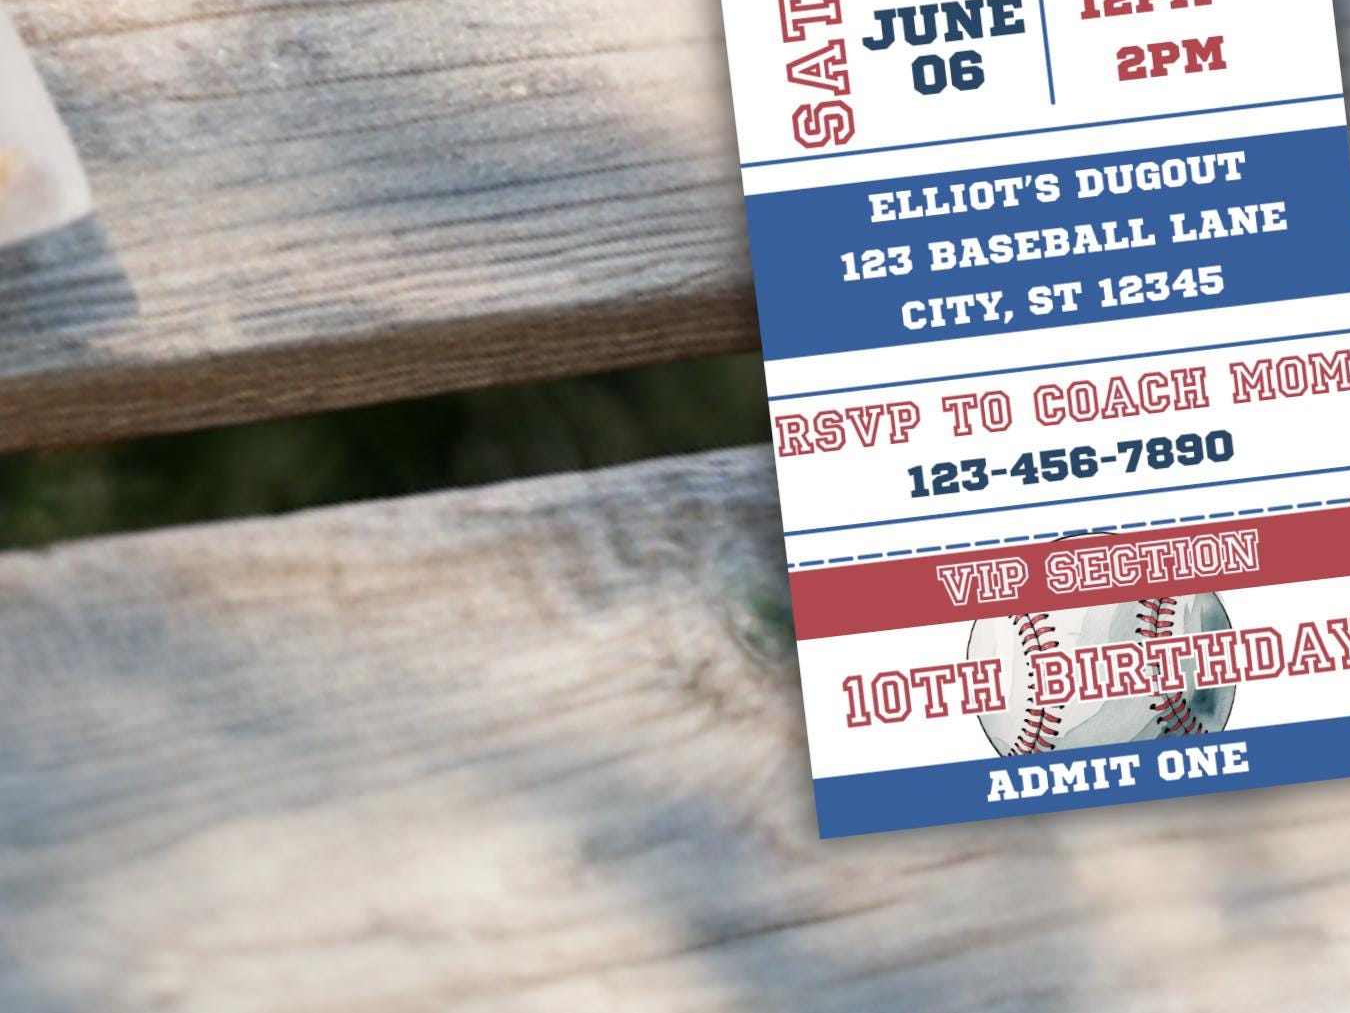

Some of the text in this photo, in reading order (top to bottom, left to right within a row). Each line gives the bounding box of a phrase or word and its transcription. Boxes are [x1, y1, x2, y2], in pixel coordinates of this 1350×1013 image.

[911, 50, 985, 96] 06
[1116, 36, 1227, 81] 2PM
[868, 151, 1246, 223] ELLIOT'S DUGOUT
[841, 202, 1288, 282] 123 BASEBALL LANE
[901, 266, 1224, 330] CITY, ST 12345
[775, 401, 920, 457] RSVP
[942, 391, 1012, 436] TO
[1033, 367, 1210, 427] COACH
[908, 430, 1234, 498] 123-456-7890
[936, 529, 1259, 606] VIP SECTION
[842, 659, 1007, 728] 10TH
[987, 741, 1250, 802] ADMIT ONE
